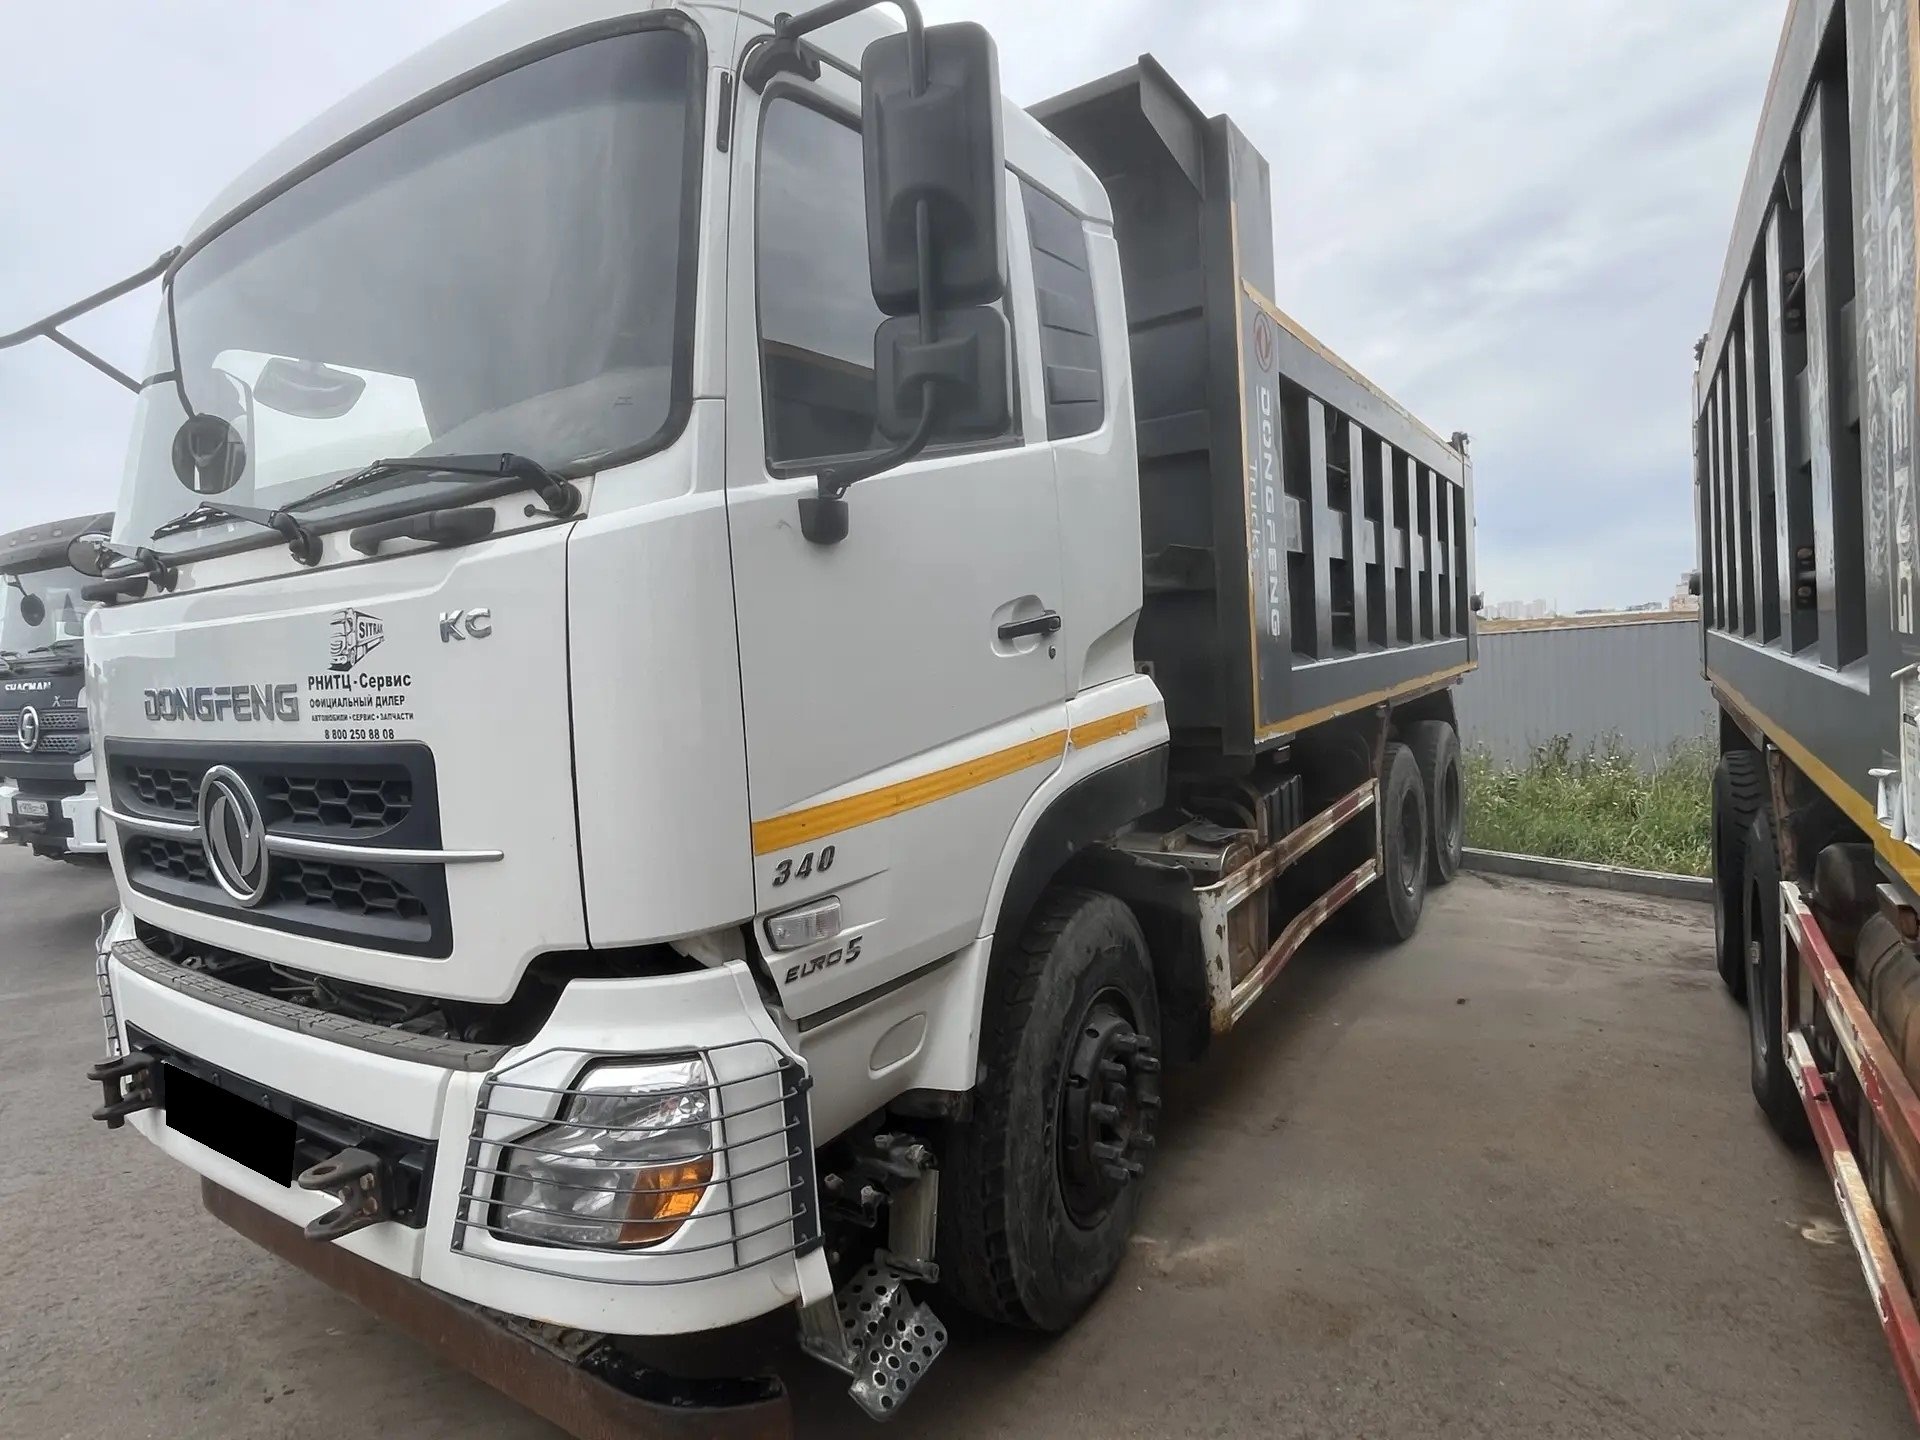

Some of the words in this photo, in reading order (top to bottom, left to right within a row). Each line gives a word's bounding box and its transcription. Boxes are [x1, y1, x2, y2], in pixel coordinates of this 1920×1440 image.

[1881, 0, 1915, 634] ONGFENG
[1260, 387, 1280, 637] DONGFENG
[143, 683, 300, 722] DONGFENG
[309, 694, 373, 709] ОФИЦИАЛЬНЫЙ
[375, 695, 405, 708] ДИЛЕР
[380, 712, 414, 720] ЗАПЧАСТИ
[324, 729, 330, 739] 8
[332, 729, 347, 740] 800
[349, 728, 366, 740] 250
[368, 728, 380, 740] 88
[382, 728, 395, 739] 08
[771, 844, 836, 888] 340
